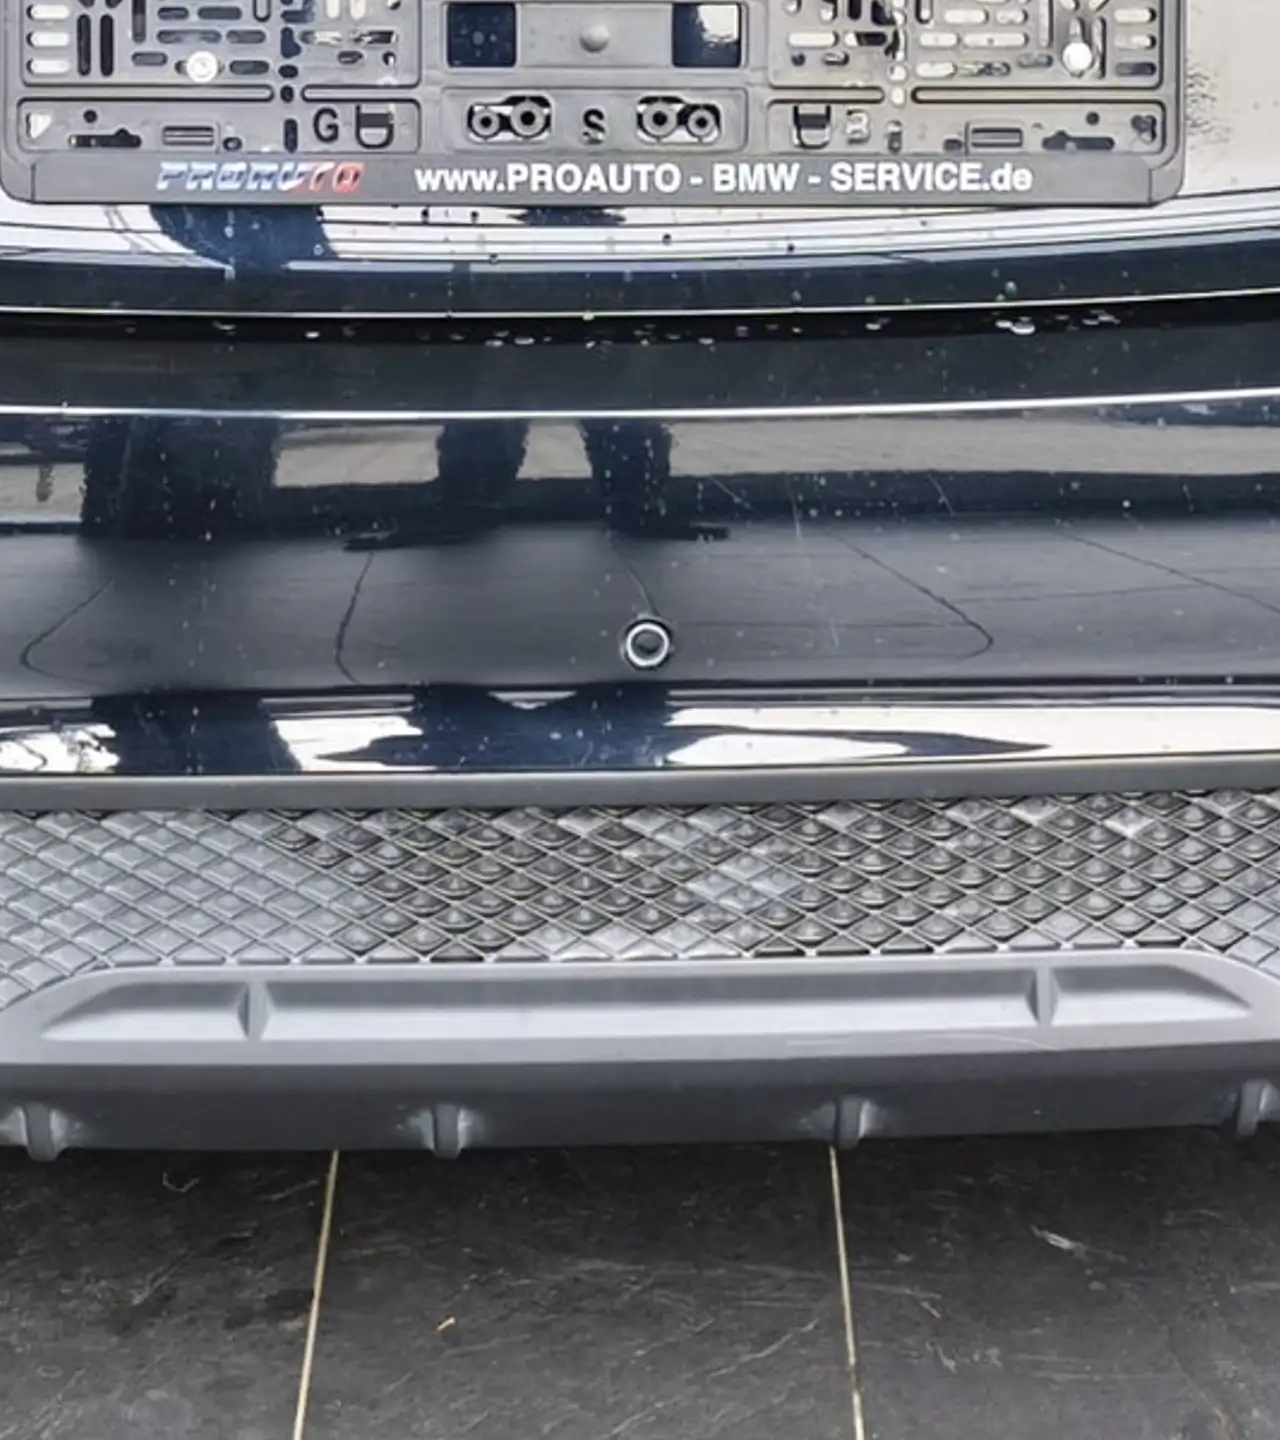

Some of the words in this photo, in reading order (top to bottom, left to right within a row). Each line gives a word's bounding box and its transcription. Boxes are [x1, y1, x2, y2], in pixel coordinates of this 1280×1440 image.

[415, 163, 681, 193] www.PROAUTO
[713, 163, 799, 192] BMW
[829, 162, 1033, 193] SERVICE.de
